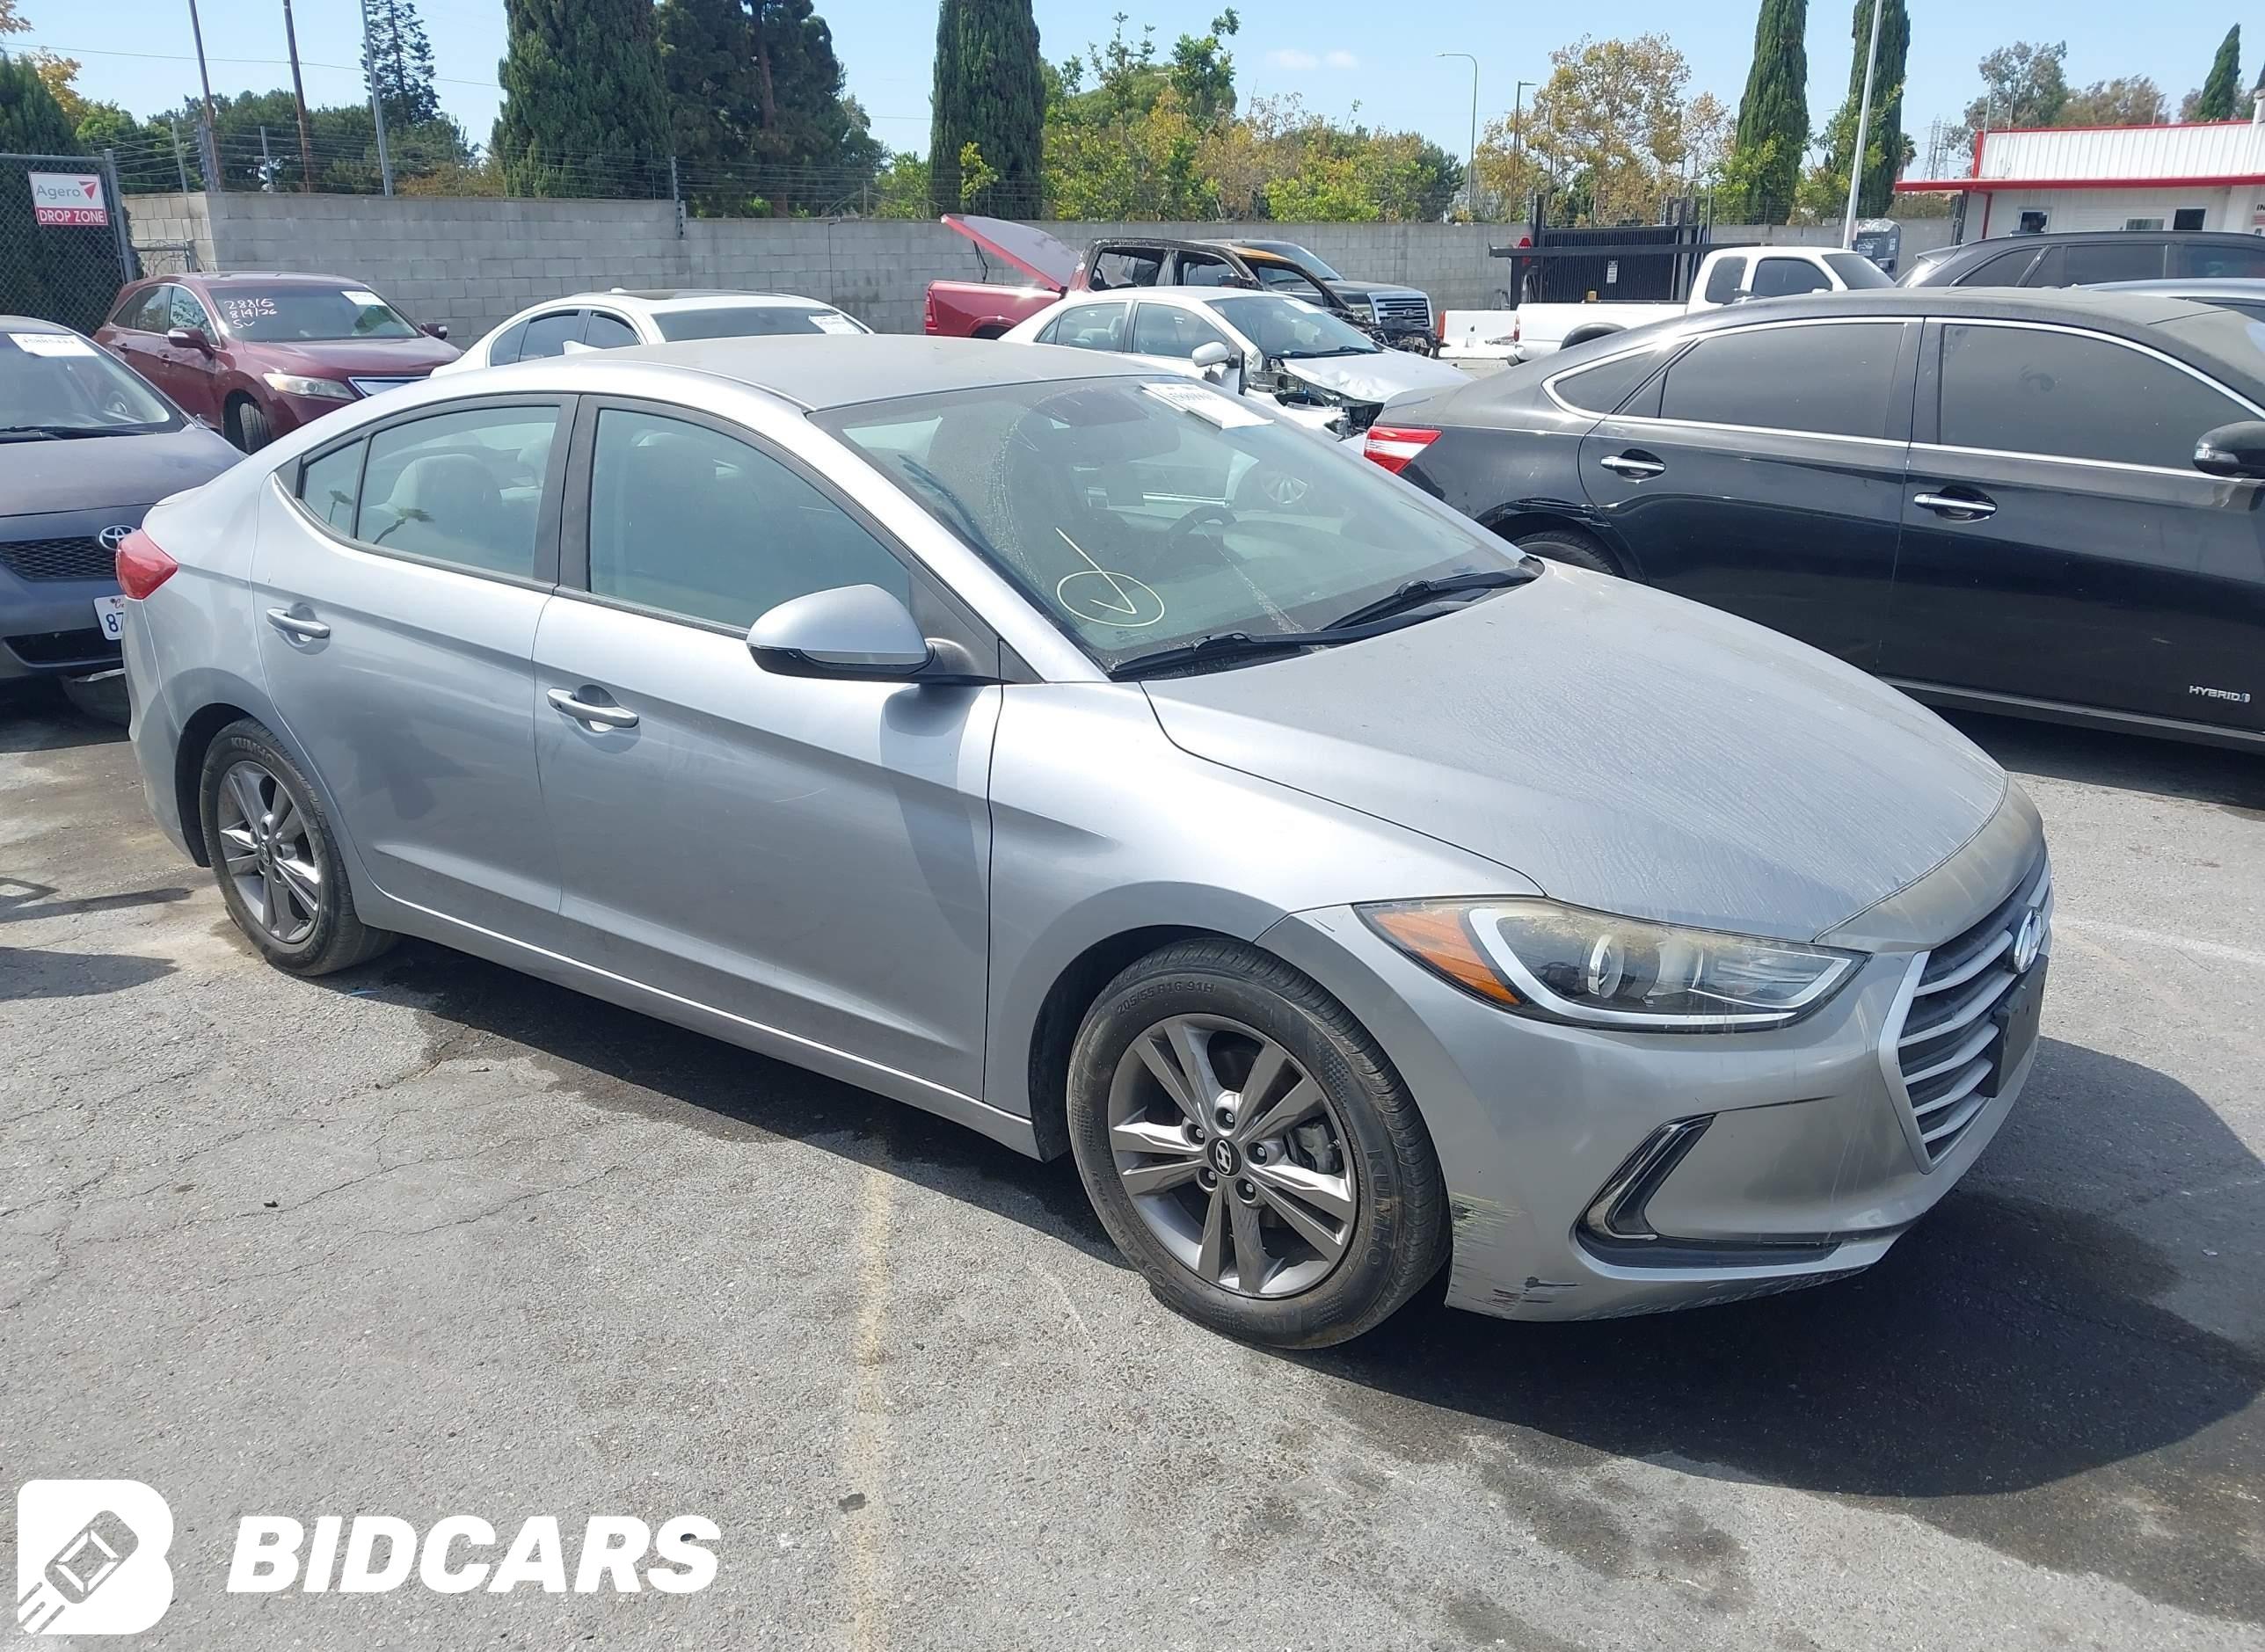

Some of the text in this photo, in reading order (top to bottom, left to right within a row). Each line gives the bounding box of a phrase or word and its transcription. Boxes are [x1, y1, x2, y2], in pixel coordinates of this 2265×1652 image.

[36, 185, 81, 200] Agero
[38, 209, 105, 222] DROP ZONE
[2189, 685, 2241, 702] HYBRID
[230, 737, 273, 764] KUMHO
[1117, 986, 1154, 1015] 205/55
[1186, 980, 1216, 993] 91H
